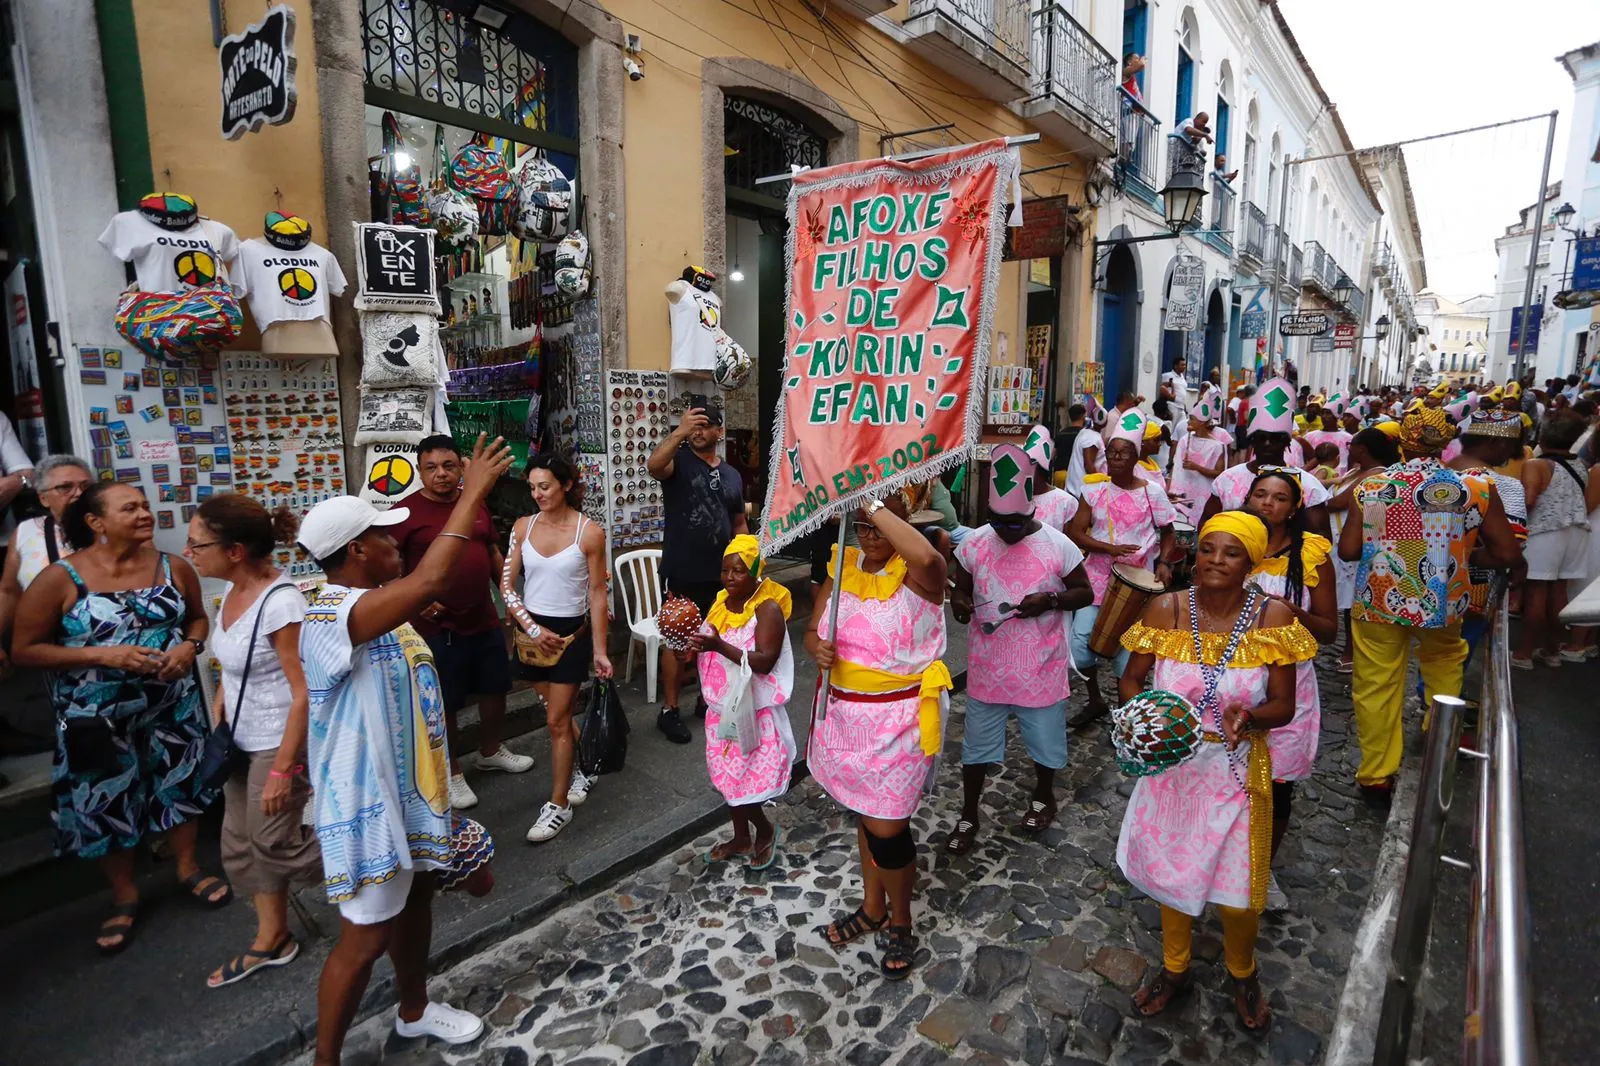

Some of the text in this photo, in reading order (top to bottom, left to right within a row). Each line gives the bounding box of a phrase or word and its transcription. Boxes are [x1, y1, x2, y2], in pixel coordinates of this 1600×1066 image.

[224, 46, 247, 106] ARTE
[229, 85, 272, 120] ARTESANATO
[826, 182, 951, 246] AFOXÉ
[157, 236, 210, 249] OLODU
[263, 257, 320, 268] OLODUM
[813, 237, 949, 292] FILHOS
[846, 286, 900, 329] DE
[1282, 315, 1326, 324] RETALHOS
[808, 332, 926, 379] KORIN
[808, 382, 912, 425] EFAN
[832, 463, 874, 496] EM:
[876, 433, 944, 479] 2002
